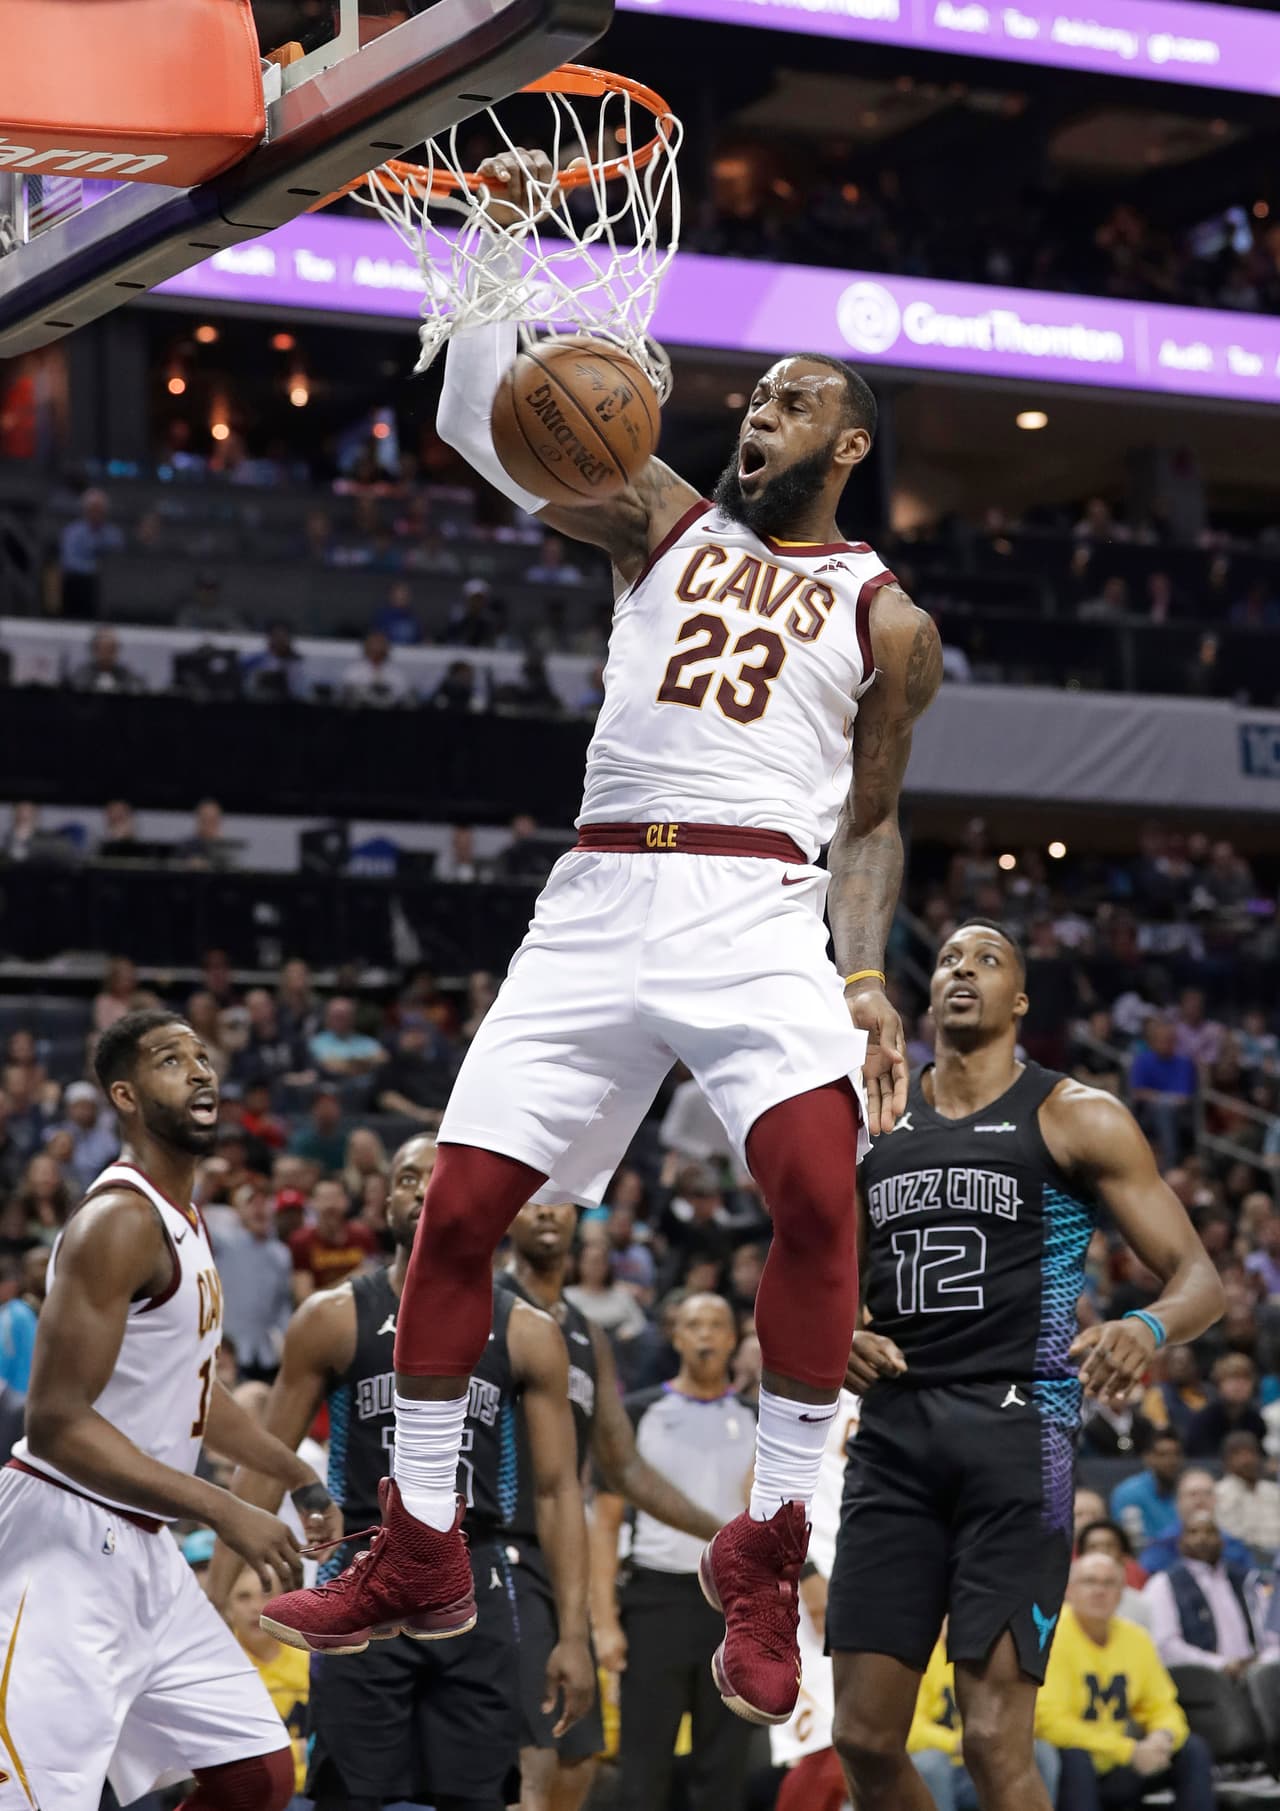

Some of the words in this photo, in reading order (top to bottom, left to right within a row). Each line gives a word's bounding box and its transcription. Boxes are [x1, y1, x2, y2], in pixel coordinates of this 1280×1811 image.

[525, 383, 616, 488] SPALDING
[674, 542, 836, 644] CAVS
[655, 612, 788, 727] 23
[645, 823, 679, 848] CLE
[868, 1168, 944, 1230] BUZZ
[946, 1167, 1025, 1222] CITY
[891, 1226, 987, 1315] 12
[1082, 1673, 1128, 1721] M
